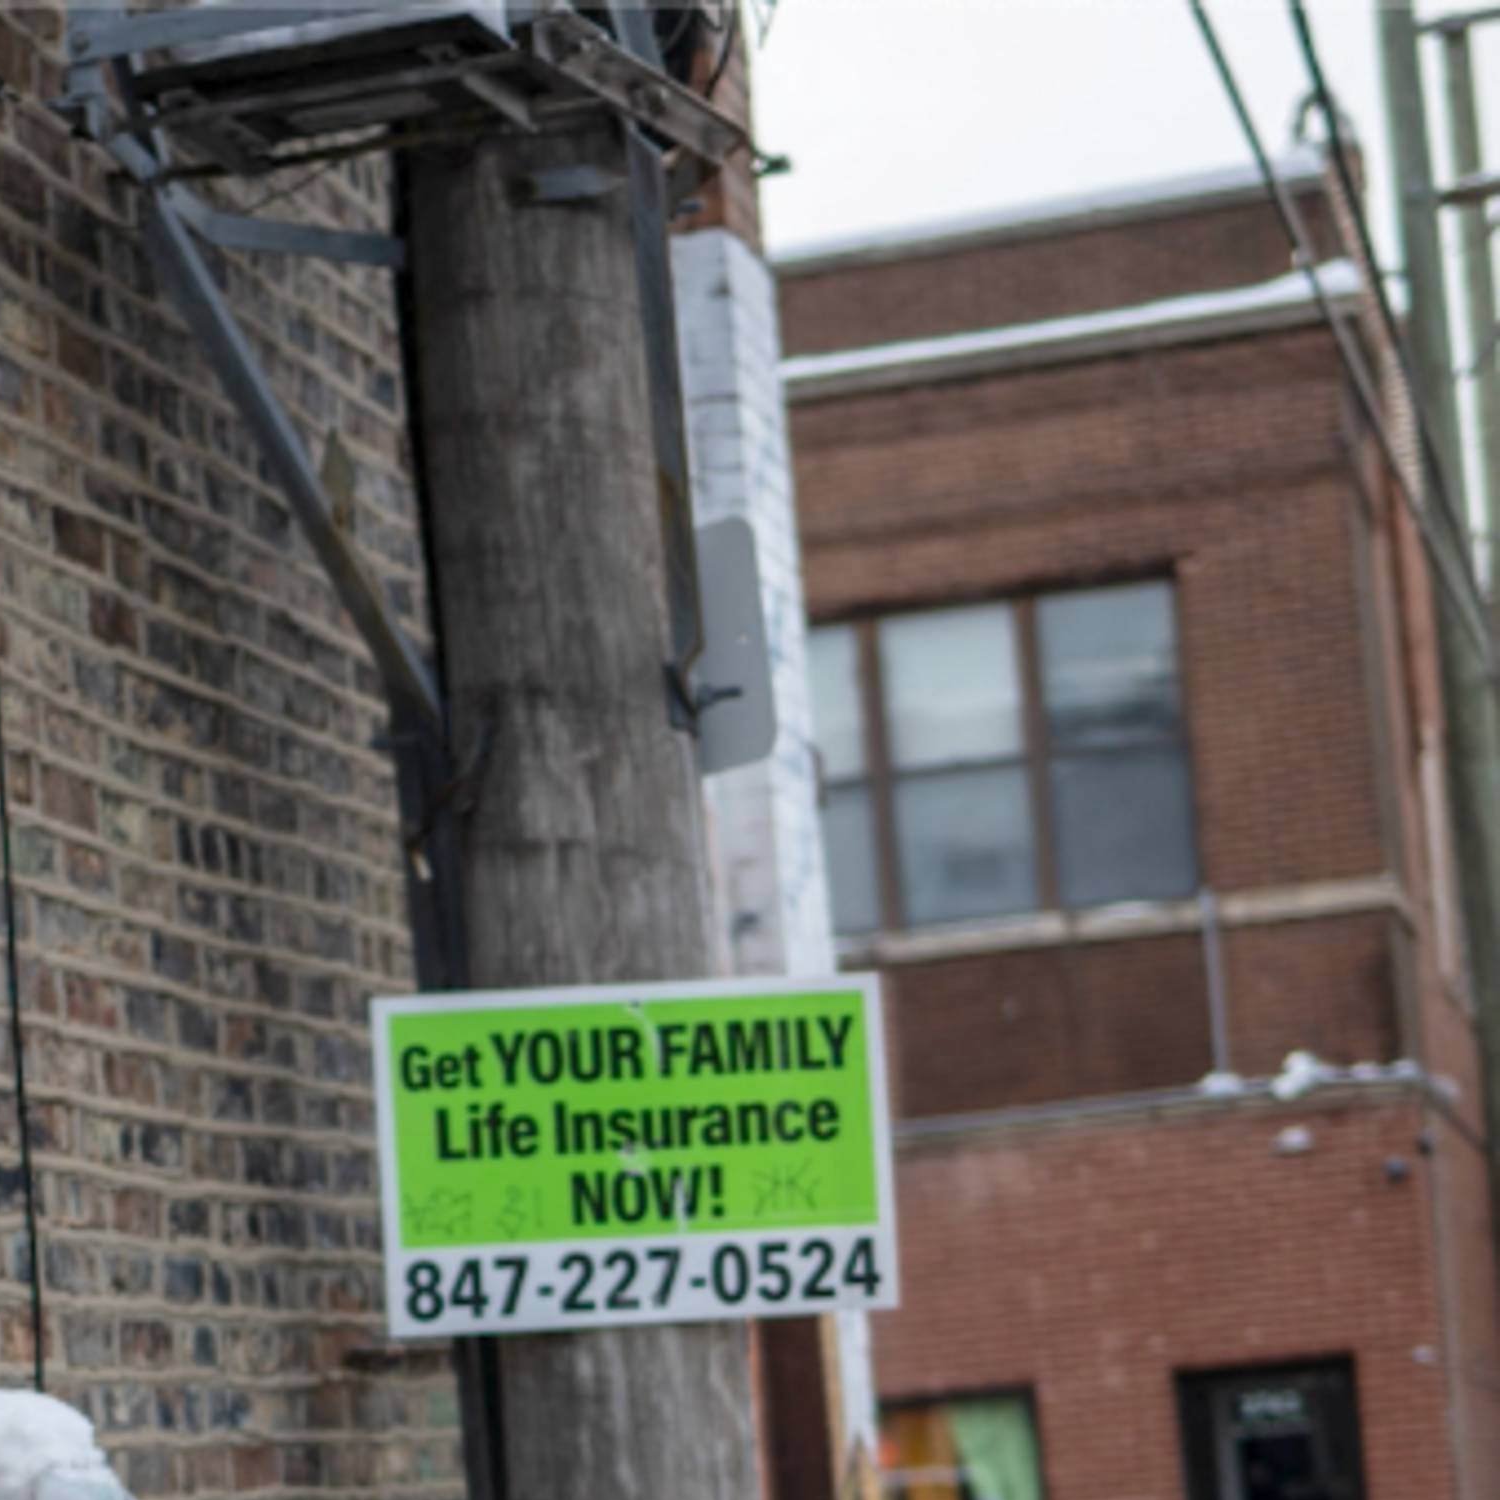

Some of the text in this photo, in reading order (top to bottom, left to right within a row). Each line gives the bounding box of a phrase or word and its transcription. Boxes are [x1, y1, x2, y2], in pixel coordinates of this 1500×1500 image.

[400, 1016, 853, 1092] Get YOUR FAMILY
[435, 1096, 840, 1161] Life Insurance
[571, 1164, 725, 1226] NOW!
[405, 1237, 881, 1323] 847-227-0524
